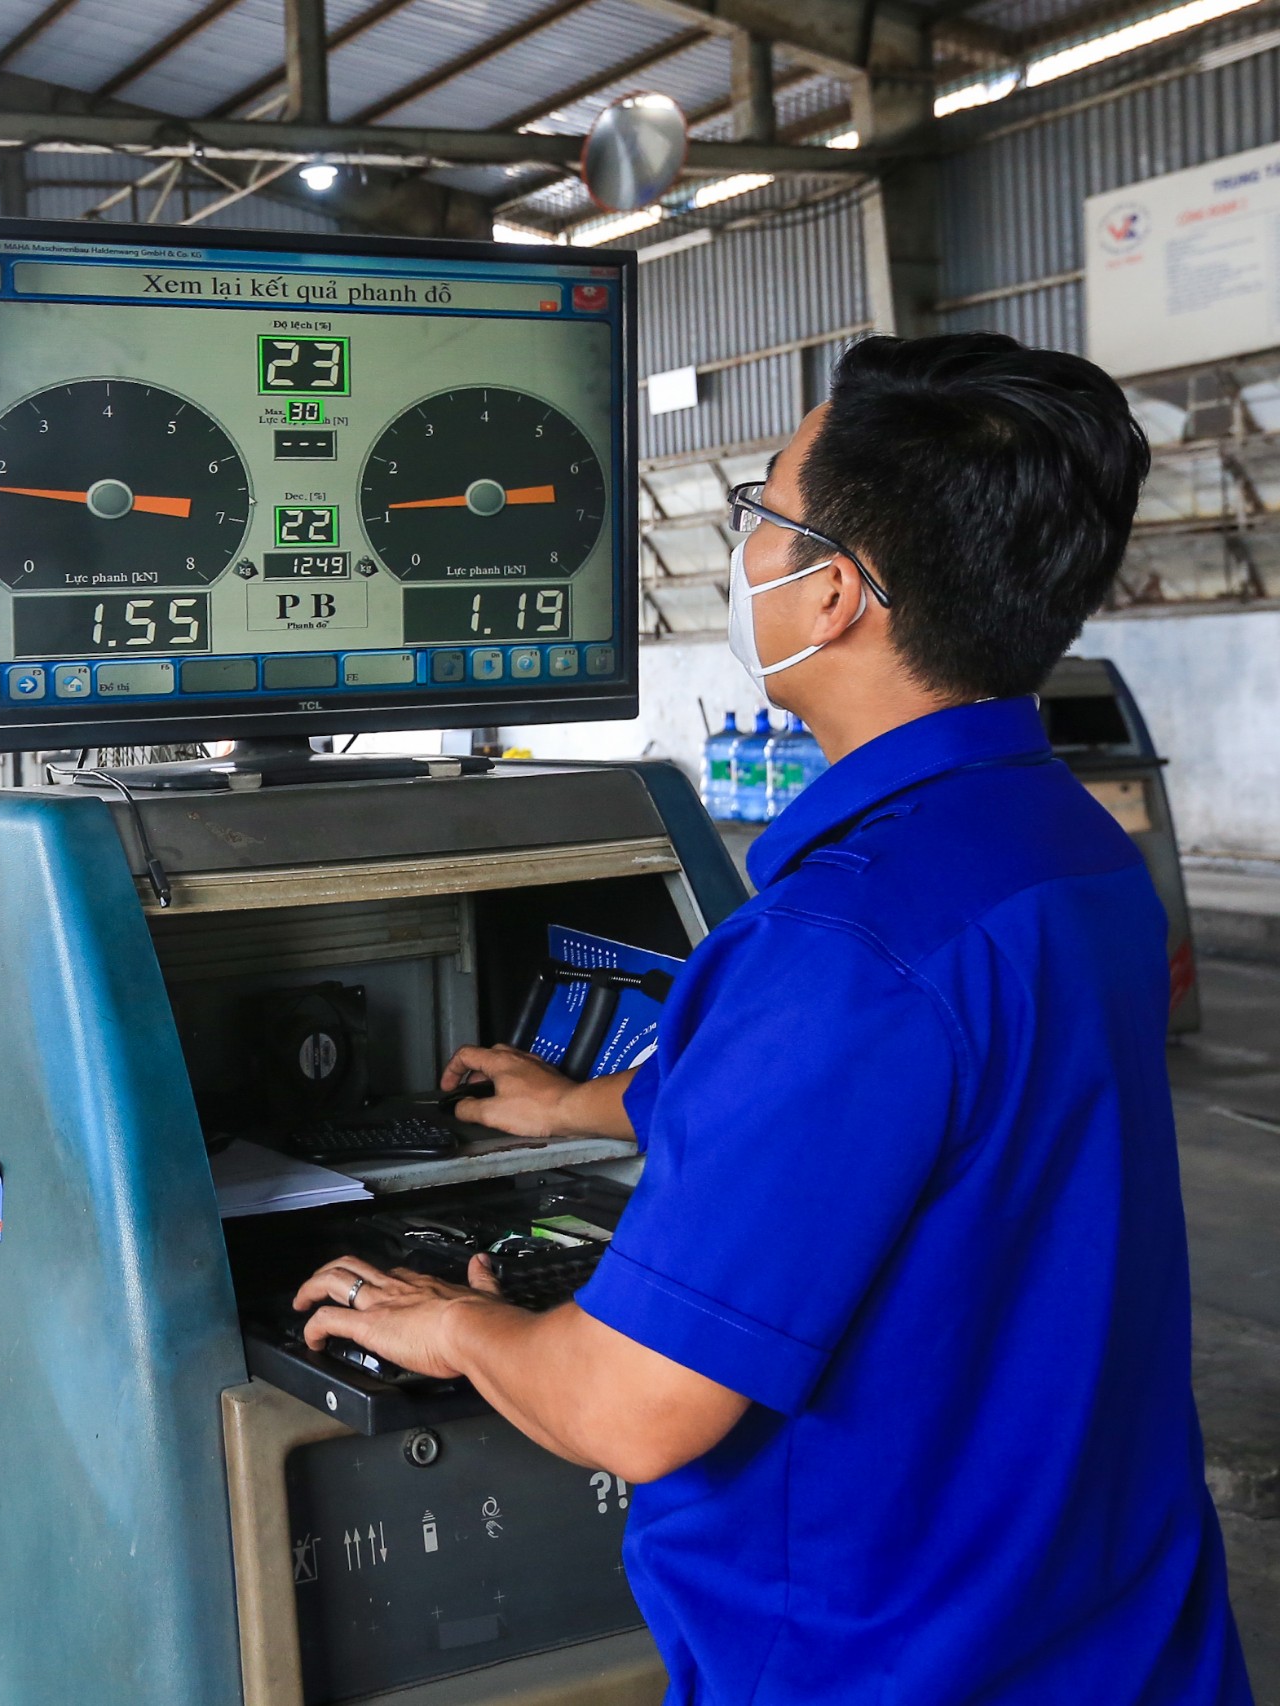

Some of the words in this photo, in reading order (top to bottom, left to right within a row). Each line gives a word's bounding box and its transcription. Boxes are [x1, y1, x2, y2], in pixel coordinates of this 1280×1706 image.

[32, 244, 89, 254] Maschinenbau
[91, 247, 139, 258] Haldenwang
[141, 249, 166, 257] GmbH
[143, 274, 202, 295] Xem
[211, 277, 241, 300] lại
[250, 276, 289, 298] kết
[296, 280, 337, 304] quả
[348, 283, 417, 305] phanh
[273, 320, 288, 330] Độ
[291, 320, 313, 330] lệch
[315, 322, 331, 331] [%]
[267, 341, 340, 386] 23
[103, 405, 113, 418] 4
[291, 403, 318, 420] 30
[481, 411, 490, 422] 4
[39, 420, 49, 433] 3
[259, 415, 278, 425] Lực
[333, 417, 348, 426] [N]
[167, 421, 176, 434] 5
[425, 424, 434, 437] 3
[535, 425, 543, 438] 5
[209, 461, 218, 473] 6
[389, 462, 398, 475] 2
[570, 462, 579, 475] 6
[285, 492, 308, 501] Dec.
[310, 492, 326, 501] [%]
[216, 511, 225, 524] 7
[384, 511, 391, 524] 1
[576, 509, 585, 521] 7
[281, 510, 331, 541] 22
[186, 557, 195, 570] 8
[411, 554, 420, 567] 0
[550, 551, 559, 564] 8
[24, 560, 34, 573] 0
[239, 566, 251, 576] kg
[294, 557, 343, 575] 1249
[360, 564, 372, 575] kg
[446, 566, 467, 578] Lực
[470, 565, 501, 576] phanh
[504, 565, 526, 576] [kN]
[65, 573, 90, 585] Lực
[92, 573, 128, 585] phanh
[132, 572, 158, 583] [kN]
[471, 589, 564, 635] 1.19
[92, 599, 199, 647] 1.55
[287, 621, 314, 630] Phanh
[32, 669, 42, 677] F3
[78, 667, 88, 675] F4
[346, 673, 359, 681] FE
[299, 701, 322, 711] TCL
